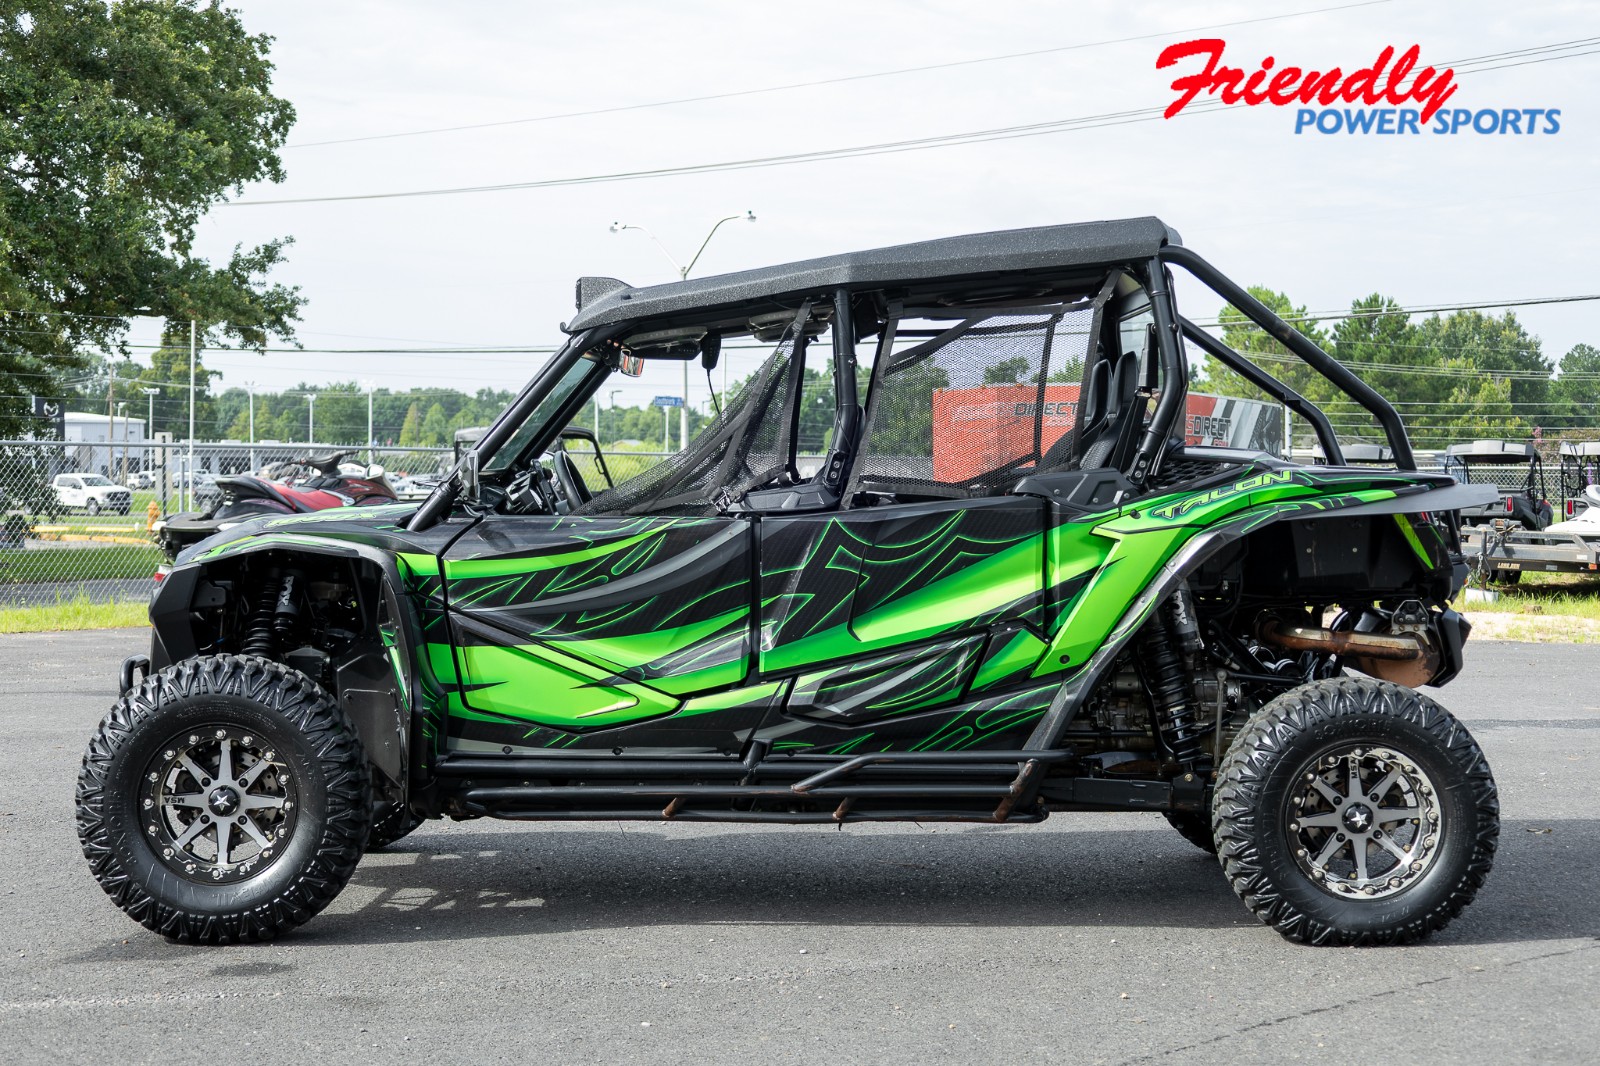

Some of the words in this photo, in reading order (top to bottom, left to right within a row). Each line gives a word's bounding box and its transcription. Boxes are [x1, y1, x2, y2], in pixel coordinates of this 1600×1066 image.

[1153, 470, 1292, 519] TALON
[276, 575, 295, 607] FOX
[1170, 590, 1188, 626] FOX
